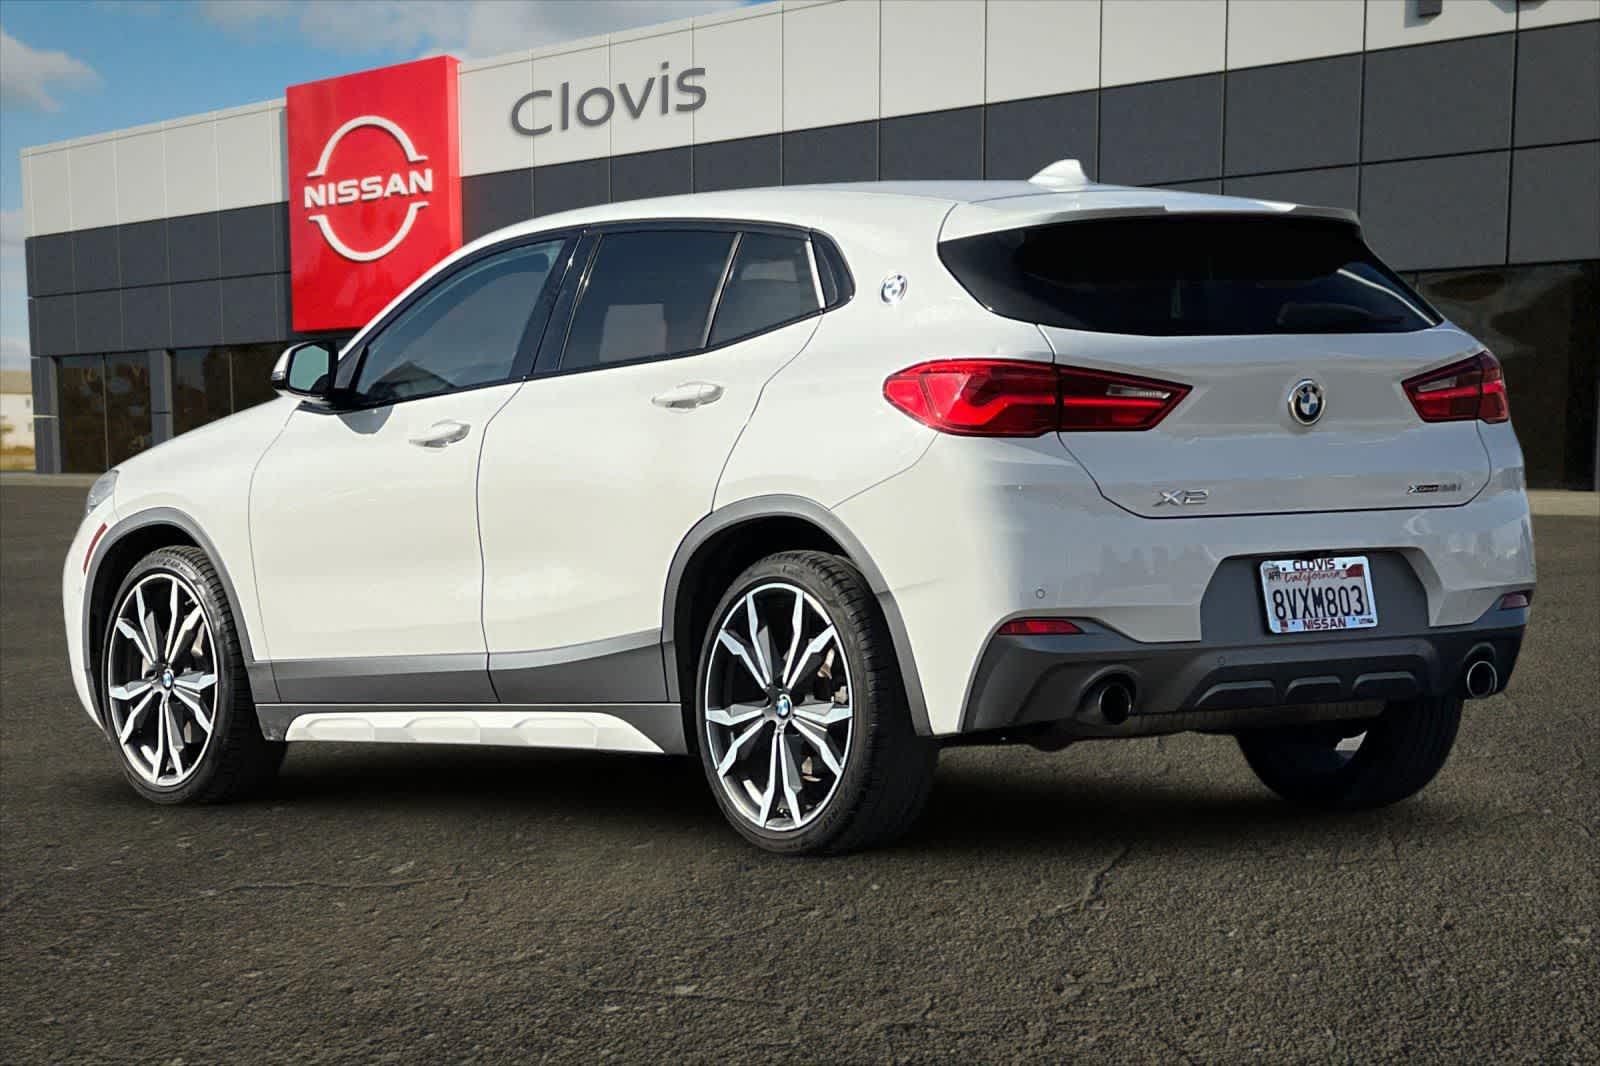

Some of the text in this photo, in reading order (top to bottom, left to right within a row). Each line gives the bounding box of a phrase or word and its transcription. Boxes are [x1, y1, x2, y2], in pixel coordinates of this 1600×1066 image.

[511, 61, 707, 136] Clovis
[303, 168, 433, 208] NISSAN
[1153, 489, 1209, 507] X2
[1293, 559, 1335, 571] CLOVIS
[1272, 585, 1365, 620] 8VXM803
[1302, 617, 1346, 630] NISSAN
